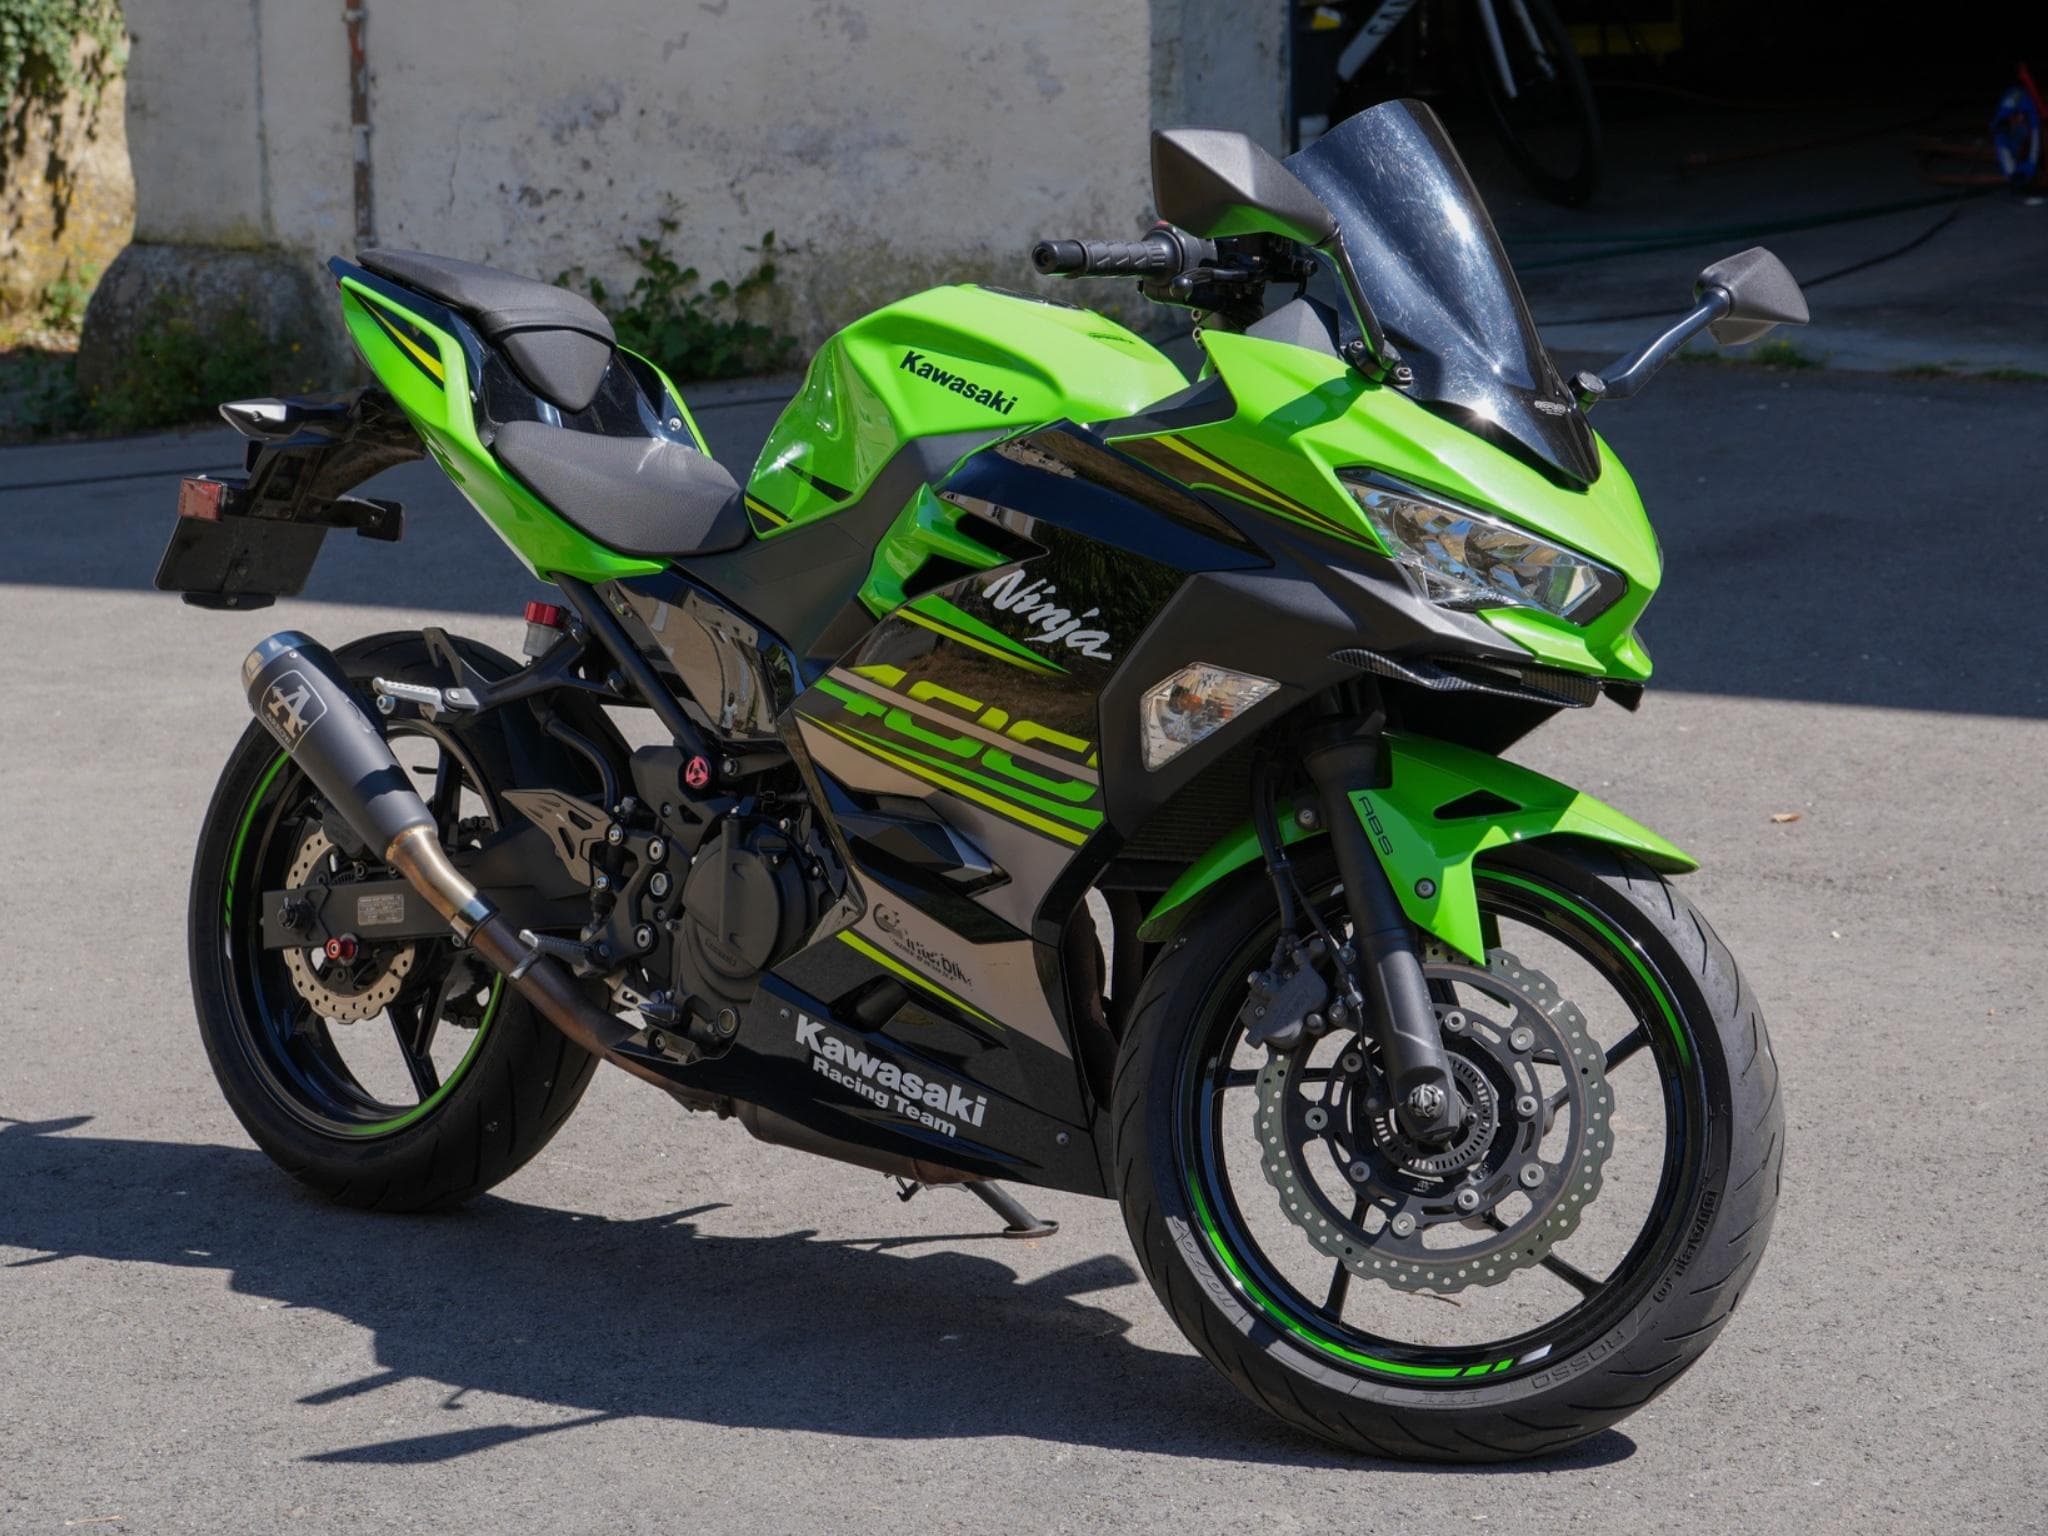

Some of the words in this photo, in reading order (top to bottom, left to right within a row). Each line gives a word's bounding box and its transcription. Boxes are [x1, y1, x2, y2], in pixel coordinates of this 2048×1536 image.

[899, 350, 1018, 415] Kawasaki
[982, 568, 1112, 661] Ninja
[1359, 796, 1394, 856] ABS
[795, 1013, 988, 1128] Kawasaki
[812, 1055, 891, 1110] Racing
[894, 1095, 957, 1139] Team
[1530, 1329, 1626, 1390] ROSSO
